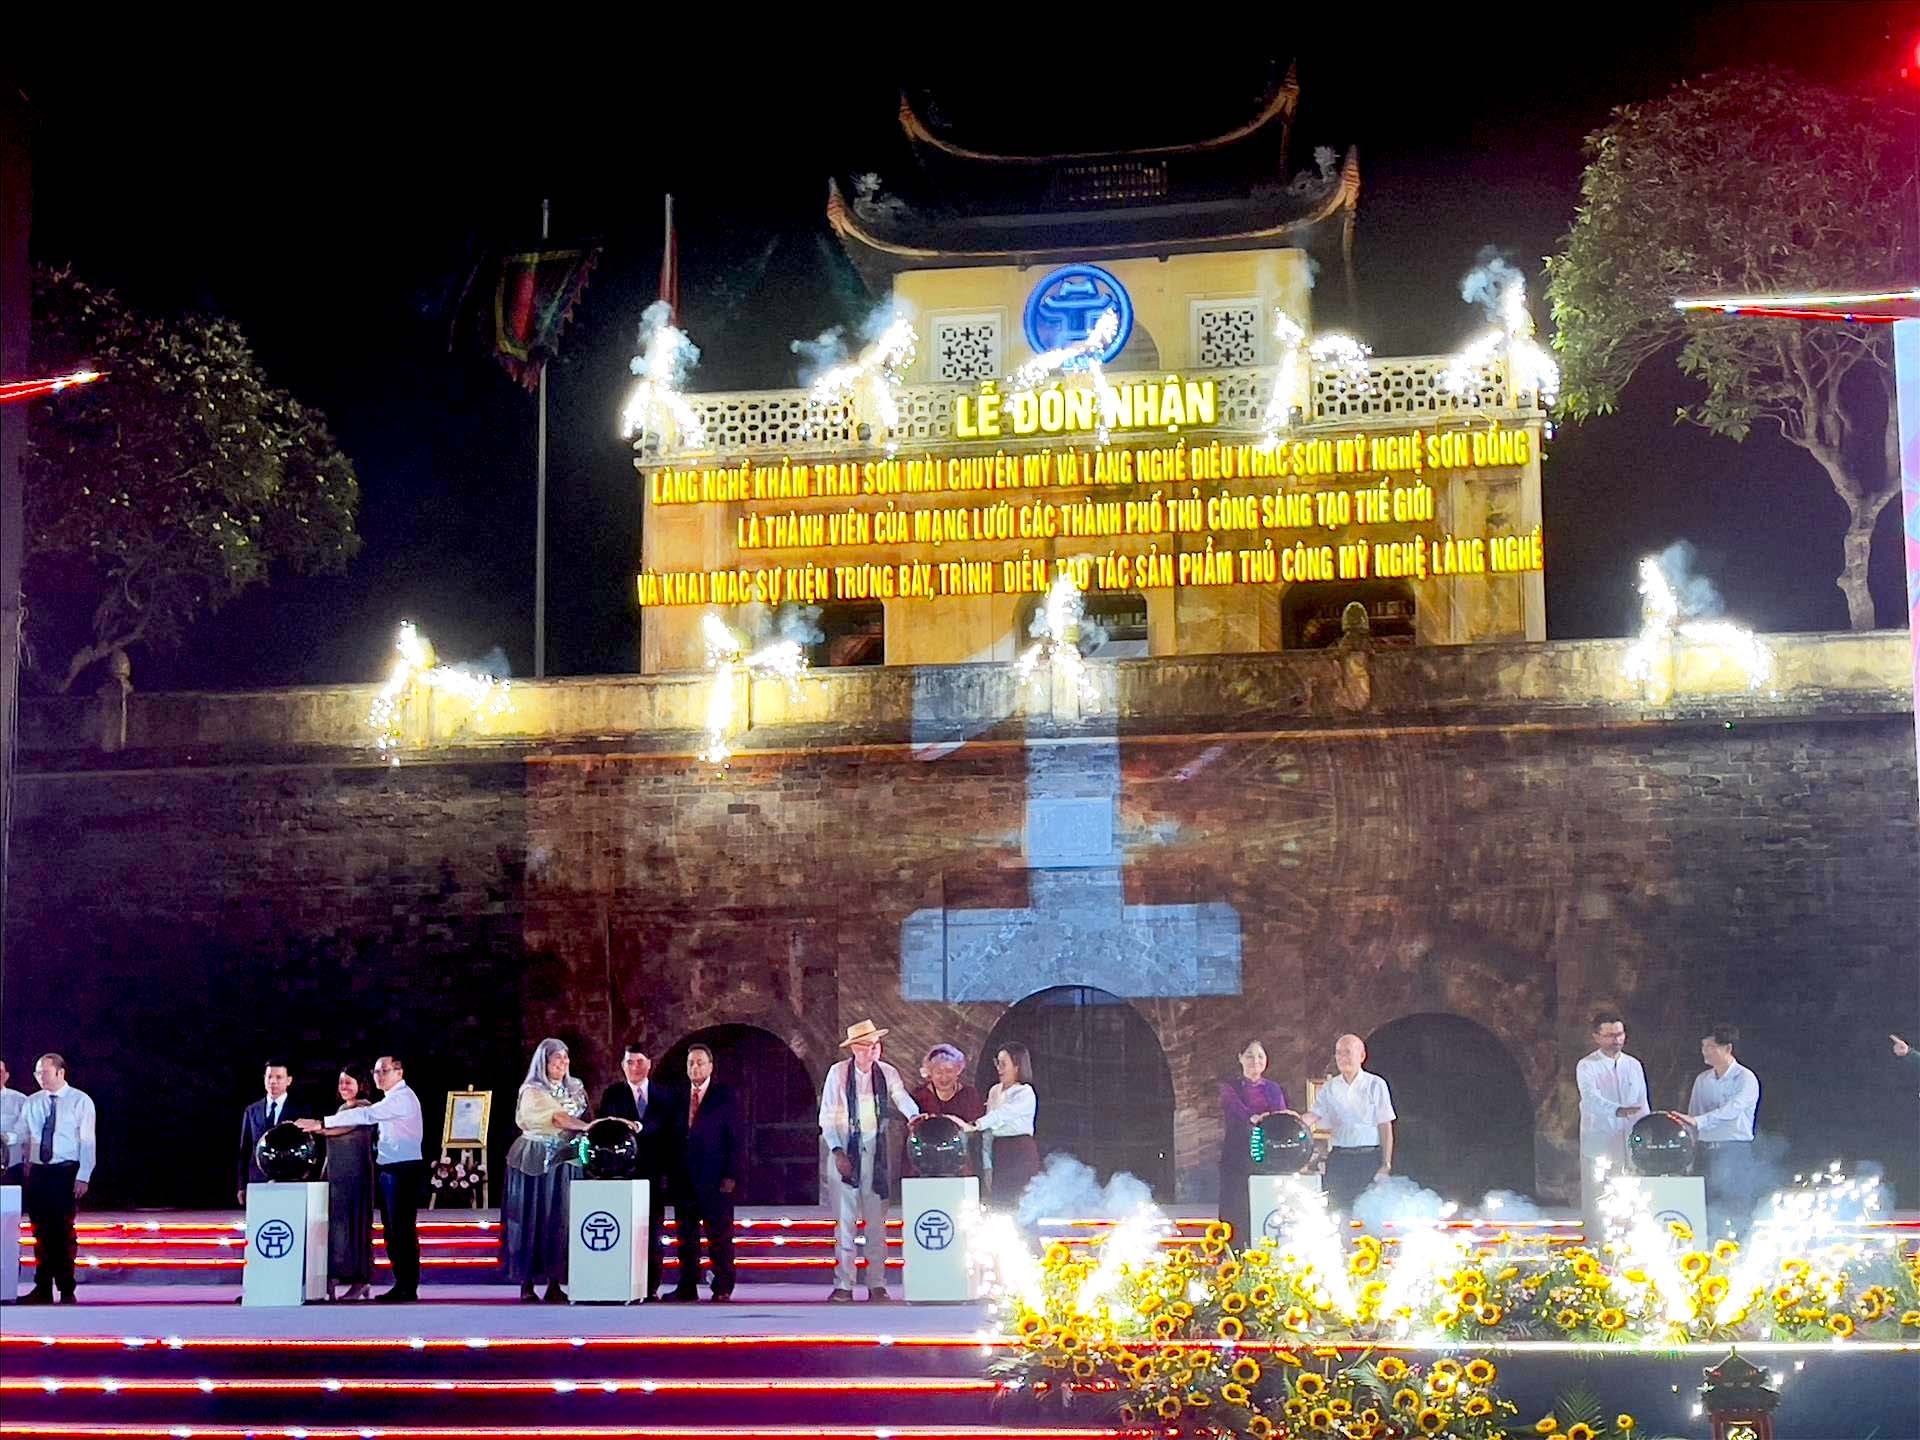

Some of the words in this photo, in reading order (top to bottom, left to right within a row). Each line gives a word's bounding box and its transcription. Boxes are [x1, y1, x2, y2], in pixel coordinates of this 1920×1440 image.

[957, 381, 1000, 437] LỄ
[1013, 381, 1093, 434] ĐÓN
[1102, 374, 1216, 433] NHẬN
[652, 466, 699, 503] LÀNG
[755, 456, 809, 499] KHẢM
[815, 463, 858, 496] TRAI
[863, 459, 900, 494] SƠN
[907, 452, 942, 492] MÀI
[948, 449, 1019, 490] CHUYÊN
[1024, 448, 1050, 487] MỸ
[1057, 446, 1079, 486] VÀ
[1084, 445, 1133, 484] LÀNG
[1293, 438, 1332, 476] SƠN
[1337, 434, 1366, 473] MỸ
[1372, 430, 1424, 474] NGHỆ
[1427, 430, 1469, 469] SƠN
[738, 512, 760, 548] LÀ
[766, 510, 824, 547] THÀNH
[830, 508, 869, 545] VIÊN
[875, 500, 909, 543] CỦA
[915, 508, 969, 546] MẠNG
[974, 500, 1015, 540] LƯỚI
[1020, 499, 1055, 538] CÁC
[1061, 496, 1122, 536] THÀNH
[1126, 490, 1162, 534] PHỐ
[1167, 486, 1203, 532] THỦ
[1208, 490, 1258, 531] CÔNG
[1262, 487, 1313, 529] SÁNG
[1316, 490, 1350, 531] TẠO
[1356, 476, 1390, 524] THẾ
[1394, 478, 1434, 522] GIỚI
[637, 568, 659, 606] VÀ
[664, 572, 706, 605] KHAI
[711, 570, 751, 607] MẠC
[756, 567, 782, 607] SỰ
[787, 562, 829, 604] KIỆN
[835, 563, 894, 599] TRƯNG
[899, 559, 934, 600] BÀY,
[939, 556, 993, 595] TRÌNH
[1096, 550, 1130, 589] TÁC
[1136, 543, 1175, 588] SẢN
[1179, 535, 1234, 586] PHẨM
[1240, 538, 1276, 583] THỦ
[1282, 540, 1335, 582] CÔNG
[1339, 538, 1369, 579] MỸ
[1375, 534, 1426, 580] NGHỆ
[1432, 534, 1485, 575] LÀNG
